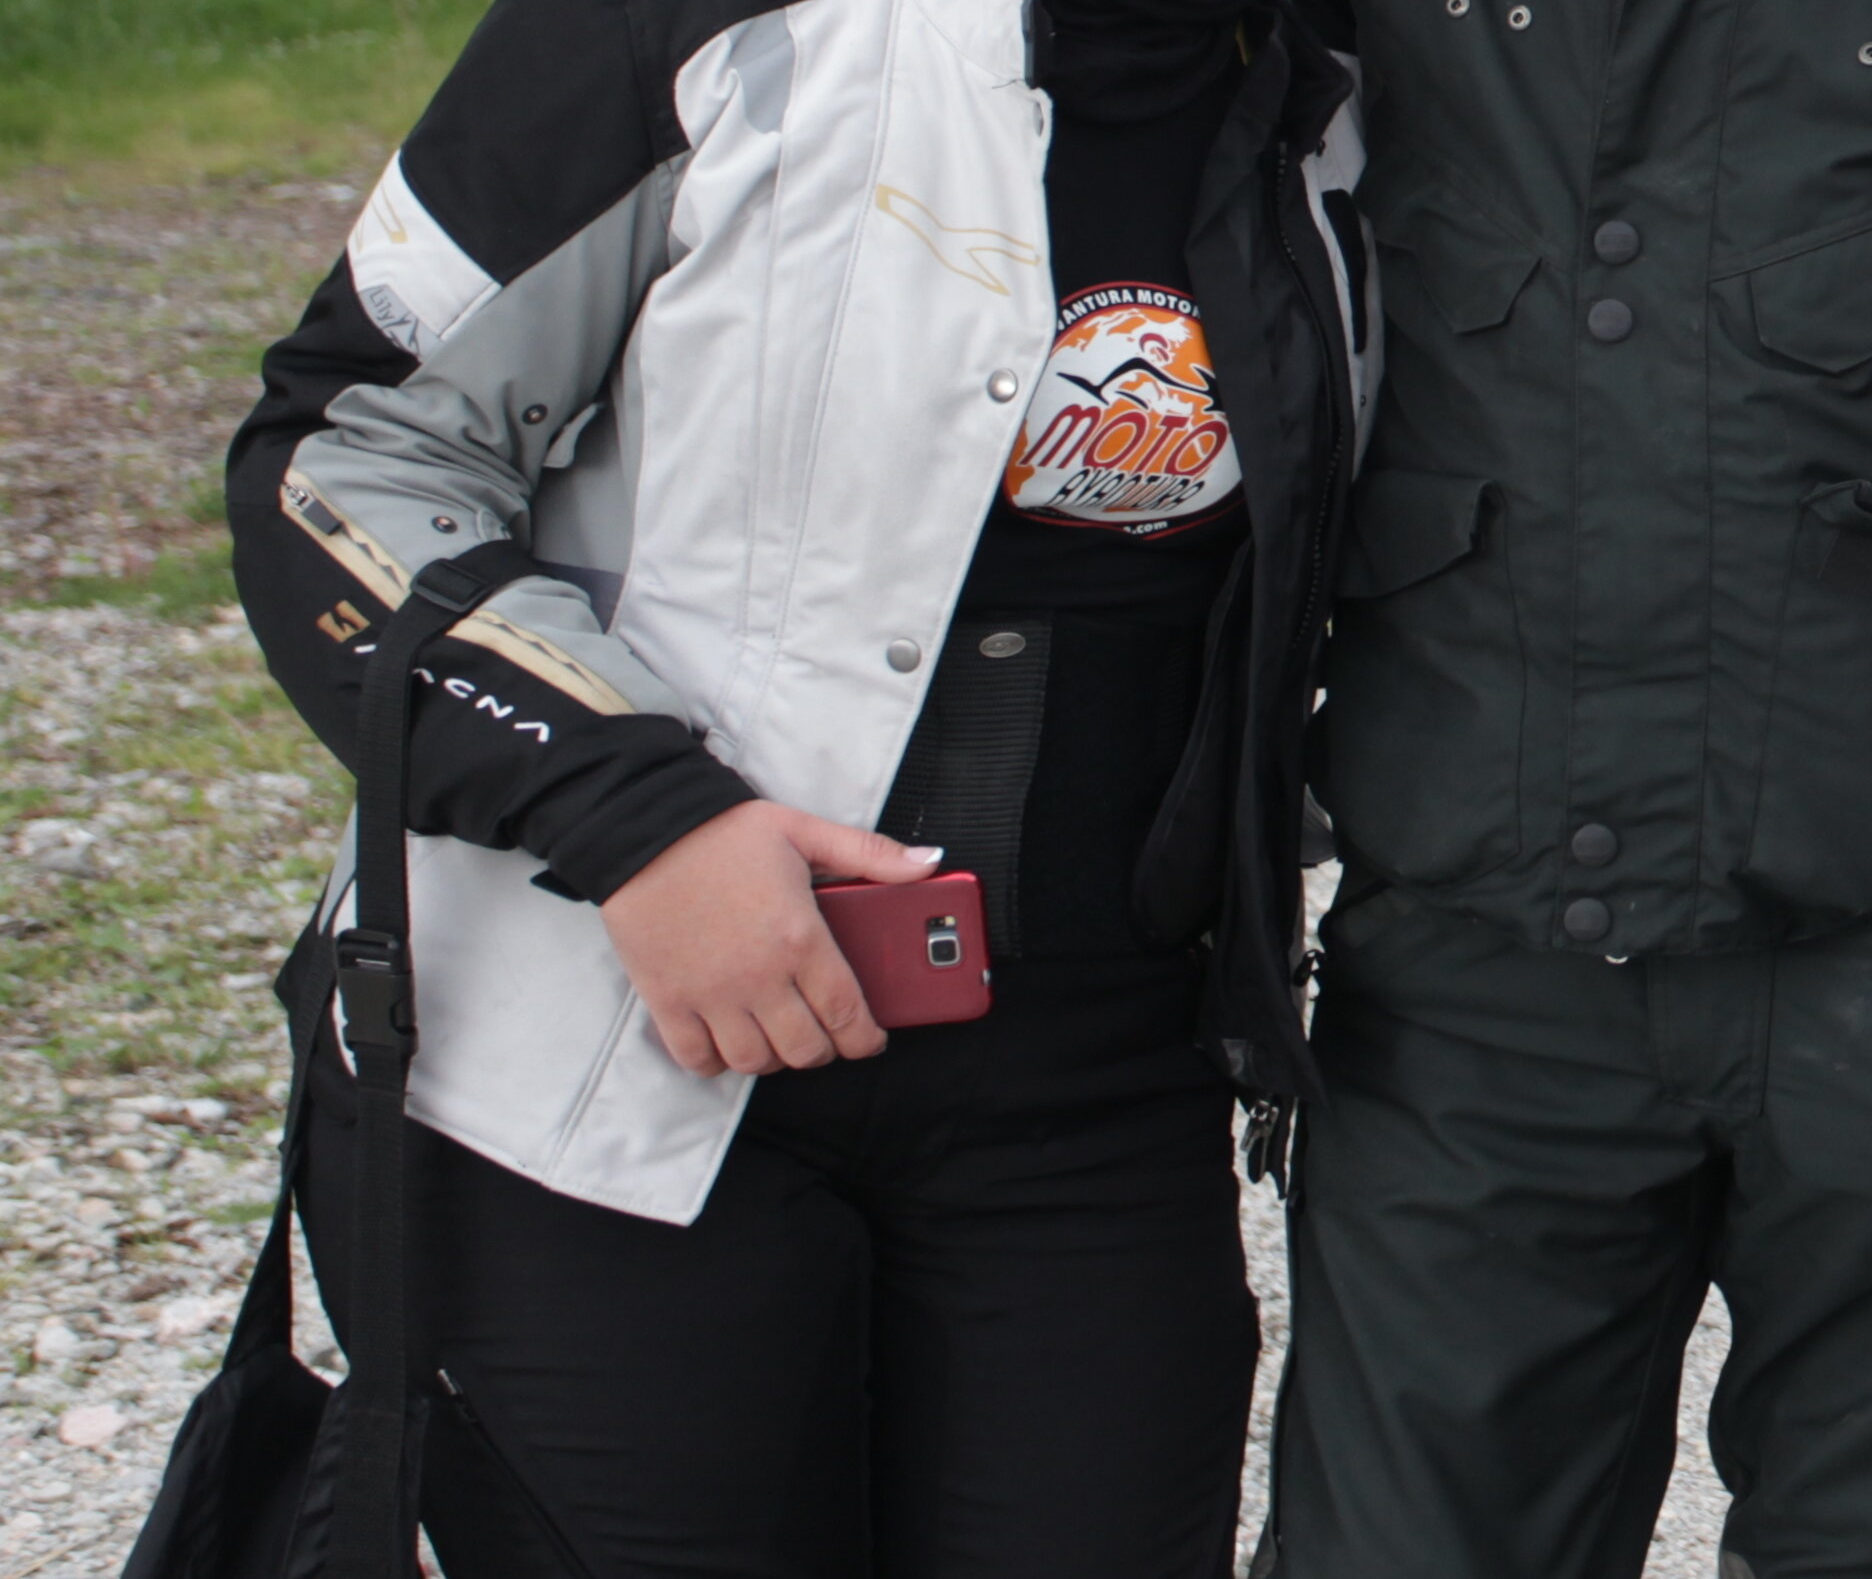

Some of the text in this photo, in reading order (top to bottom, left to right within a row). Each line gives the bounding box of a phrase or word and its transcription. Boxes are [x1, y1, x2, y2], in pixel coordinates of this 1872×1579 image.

[369, 289, 394, 321] Lily
[1018, 403, 1229, 476] MOTO
[354, 642, 550, 743] ACNA
